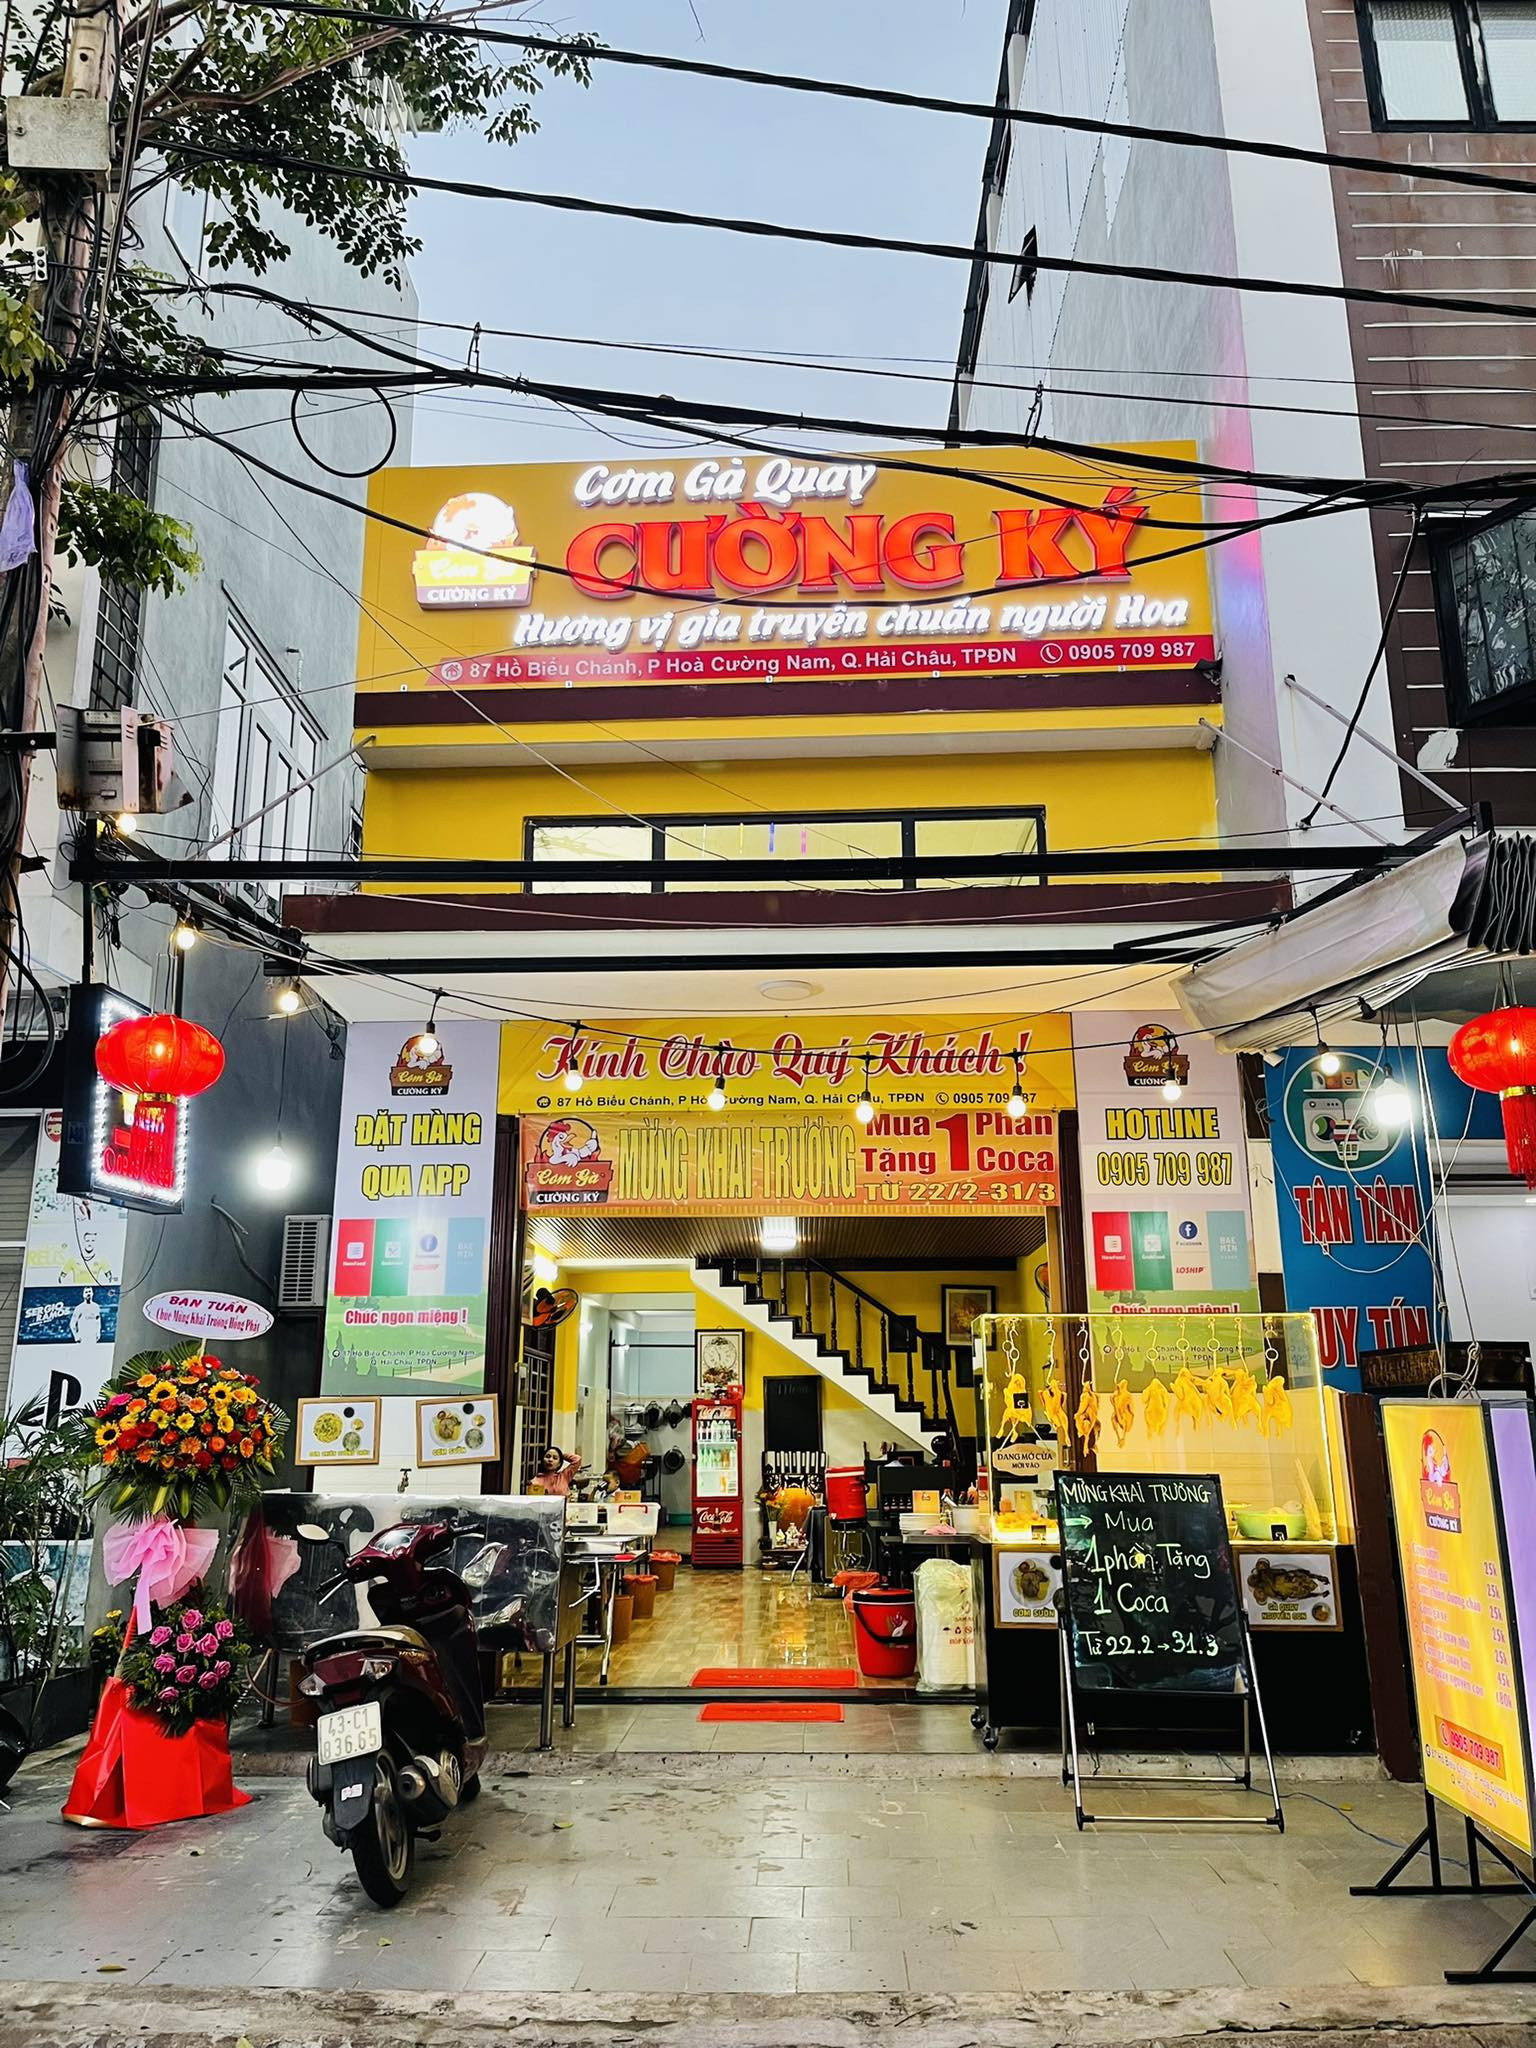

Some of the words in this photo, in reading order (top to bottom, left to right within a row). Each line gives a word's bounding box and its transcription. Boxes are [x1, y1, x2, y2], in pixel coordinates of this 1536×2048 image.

[574, 464, 674, 507] Cơm
[684, 457, 743, 503] Gà
[752, 459, 877, 507] Quay
[565, 502, 966, 600] CƯỜNG
[991, 487, 1151, 587] KÝ
[513, 612, 631, 653] Hương
[639, 612, 676, 651] vị
[678, 608, 742, 648] gia
[1000, 594, 1109, 638] người
[1114, 593, 1190, 630] Hoa
[469, 662, 490, 677] 87
[496, 658, 522, 677] Hồ
[575, 657, 643, 678] Chánh,
[648, 659, 660, 674] P
[711, 655, 781, 678] Cường
[787, 653, 837, 673] Nam,
[842, 652, 863, 672] Q.
[900, 649, 958, 669] Châu,
[961, 647, 1017, 664] TPĐN
[1068, 644, 1115, 661] 0905
[1120, 642, 1156, 660] 709
[1160, 641, 1196, 659] 987
[657, 1033, 761, 1080] Chào
[772, 1032, 853, 1088] Quý
[864, 1030, 1005, 1078] Khách
[557, 1096, 571, 1107] 87
[630, 1094, 675, 1107] Chánh,
[678, 1096, 687, 1105] P
[768, 1095, 801, 1107] Nam,
[804, 1094, 819, 1106] Q.
[888, 1093, 925, 1103] TPĐN
[953, 1093, 983, 1104] 0905
[987, 1093, 1010, 1104] 709
[354, 1109, 407, 1153] ĐẶT
[410, 1108, 483, 1146] HÀNG
[1105, 1107, 1220, 1140] HOTLINE
[617, 1118, 689, 1201] MỪNG
[695, 1126, 752, 1199] KHAI
[865, 1113, 931, 1136] Mua
[935, 1113, 970, 1172] 1
[535, 1169, 573, 1186] Cơm
[575, 1168, 600, 1187] Gà
[860, 1147, 936, 1177] Tặng
[976, 1145, 1056, 1174] Coca
[1097, 1152, 1150, 1186] 0905
[1154, 1152, 1192, 1186] 709
[1196, 1152, 1233, 1186] 987
[361, 1164, 414, 1201] QUA
[417, 1164, 471, 1197] APP
[536, 1191, 581, 1204] CƯỜNG
[908, 1181, 1057, 1203] 22/2-31/3
[1354, 1174, 1421, 1244] TÂM
[25, 1302, 65, 1319] SERGIO
[36, 1306, 71, 1324] RAMOS
[345, 1310, 378, 1324] Chúc
[382, 1311, 413, 1325] ngon
[418, 1309, 458, 1327] miệng
[1310, 1306, 1358, 1367] UY
[1366, 1297, 1431, 1350] TÍN
[1105, 1510, 1154, 1533] Mua
[1156, 1543, 1211, 1580] Tặng
[1093, 1577, 1112, 1615] 1
[1117, 1582, 1170, 1613] Coca
[1488, 1604, 1503, 1622] 25k
[1490, 1625, 1506, 1644] 25k
